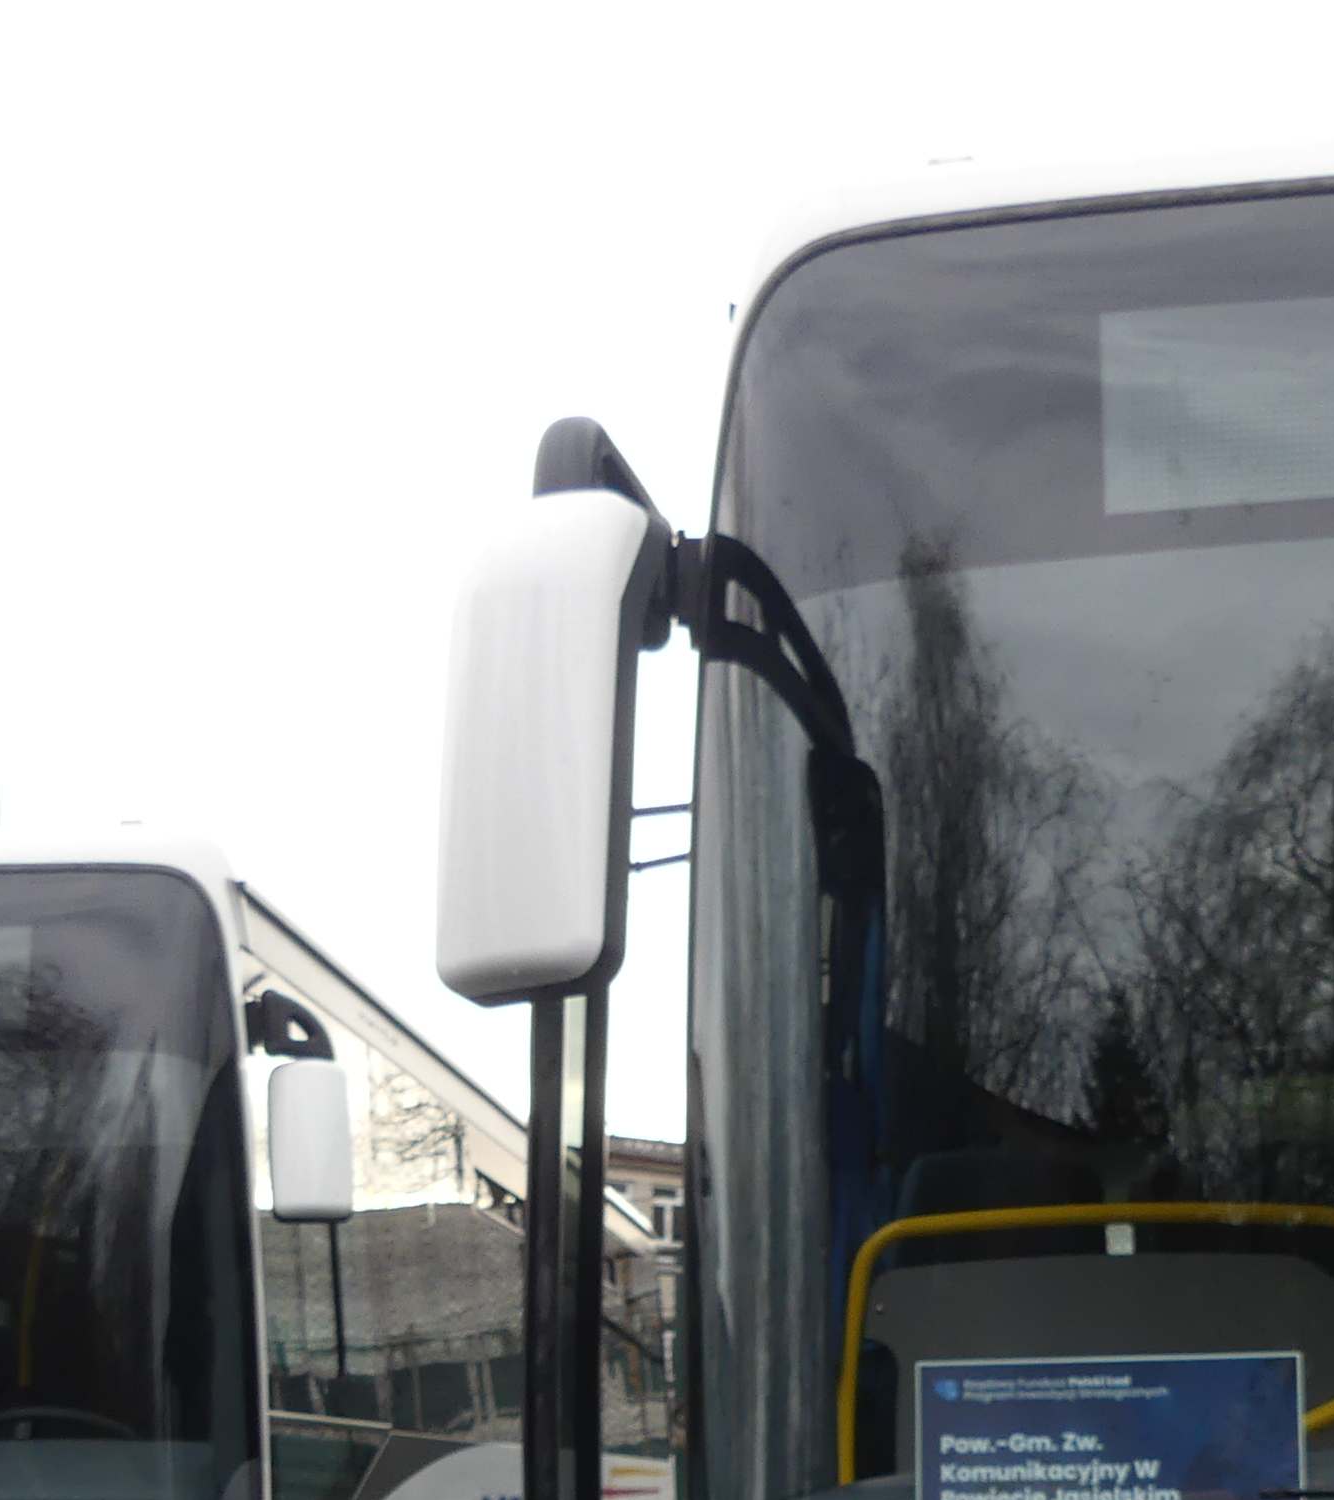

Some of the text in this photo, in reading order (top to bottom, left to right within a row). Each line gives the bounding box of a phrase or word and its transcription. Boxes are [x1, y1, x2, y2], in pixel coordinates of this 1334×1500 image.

[1062, 1431, 1104, 1451] Zw.
[940, 1459, 1162, 1485] Komunikacyjny W
